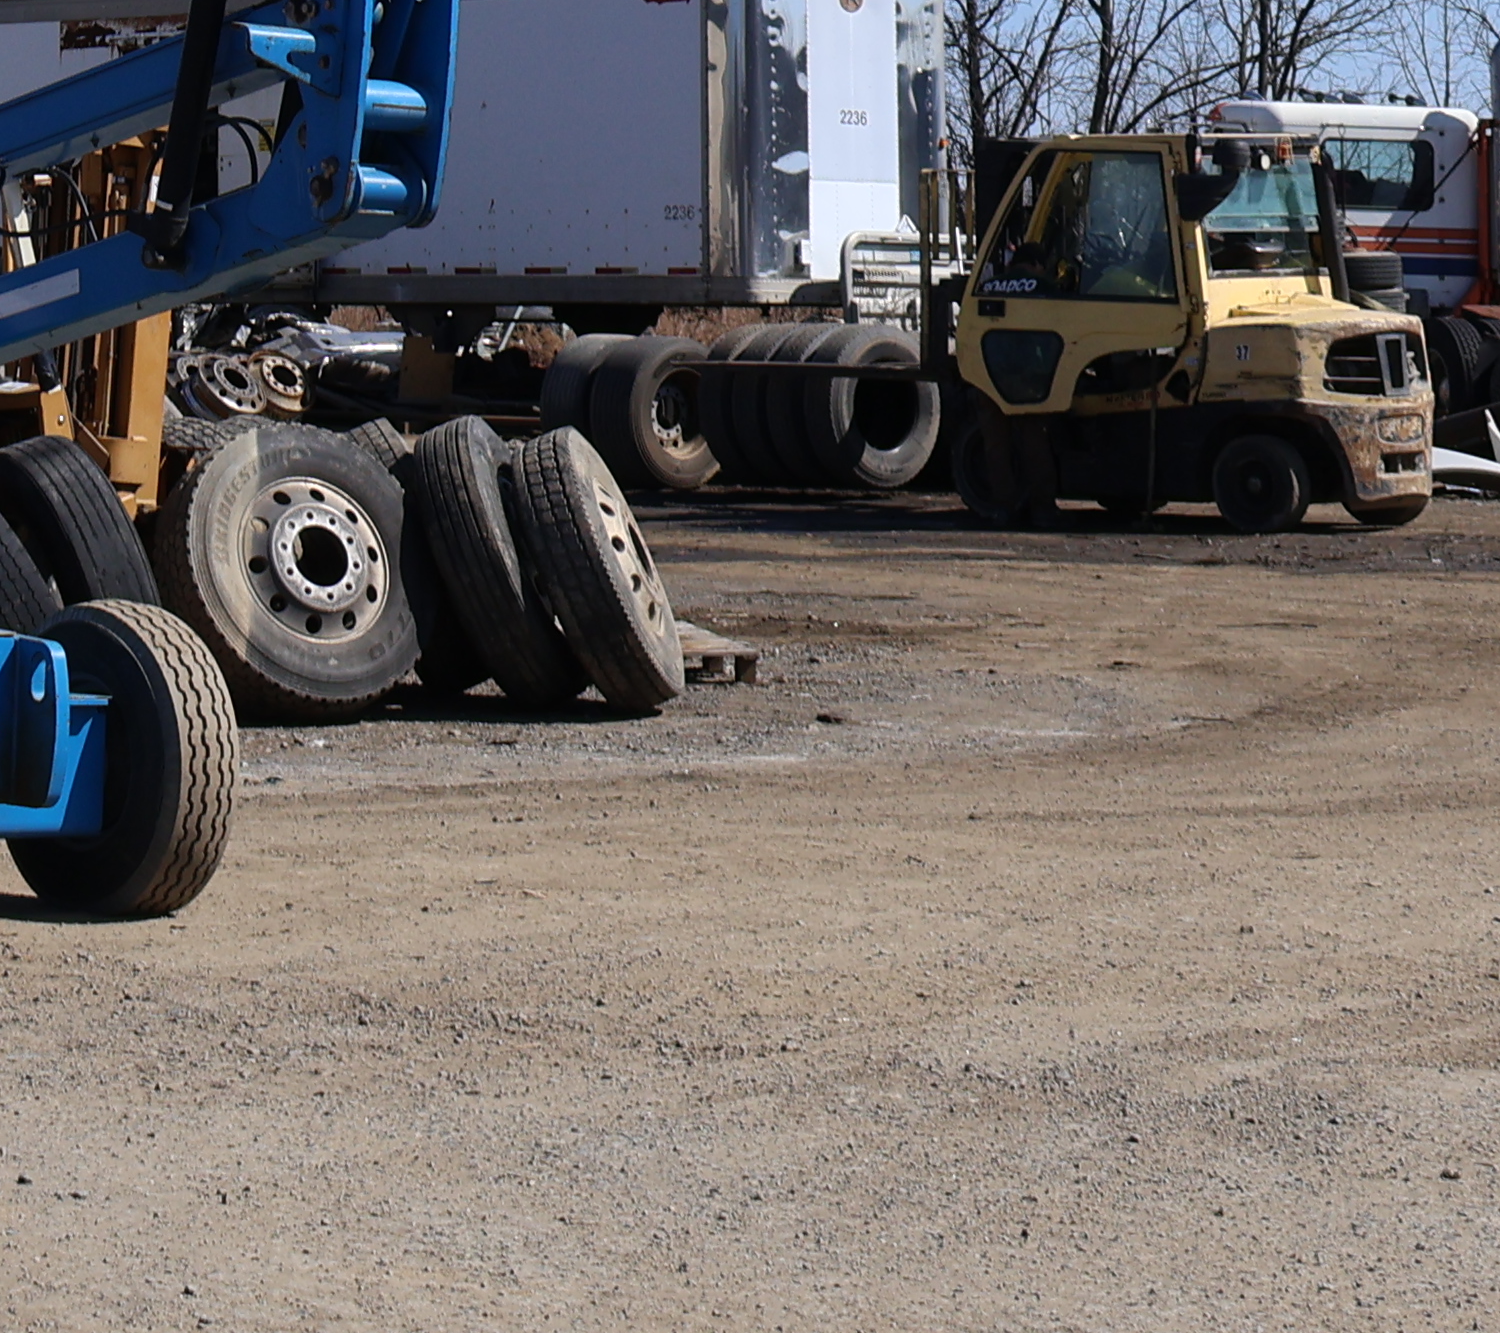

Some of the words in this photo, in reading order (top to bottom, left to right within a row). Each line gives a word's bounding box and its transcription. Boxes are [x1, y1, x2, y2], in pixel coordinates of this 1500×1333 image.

[840, 110, 867, 126] 2236
[664, 205, 695, 221] 2236
[1235, 345, 1250, 361] 37
